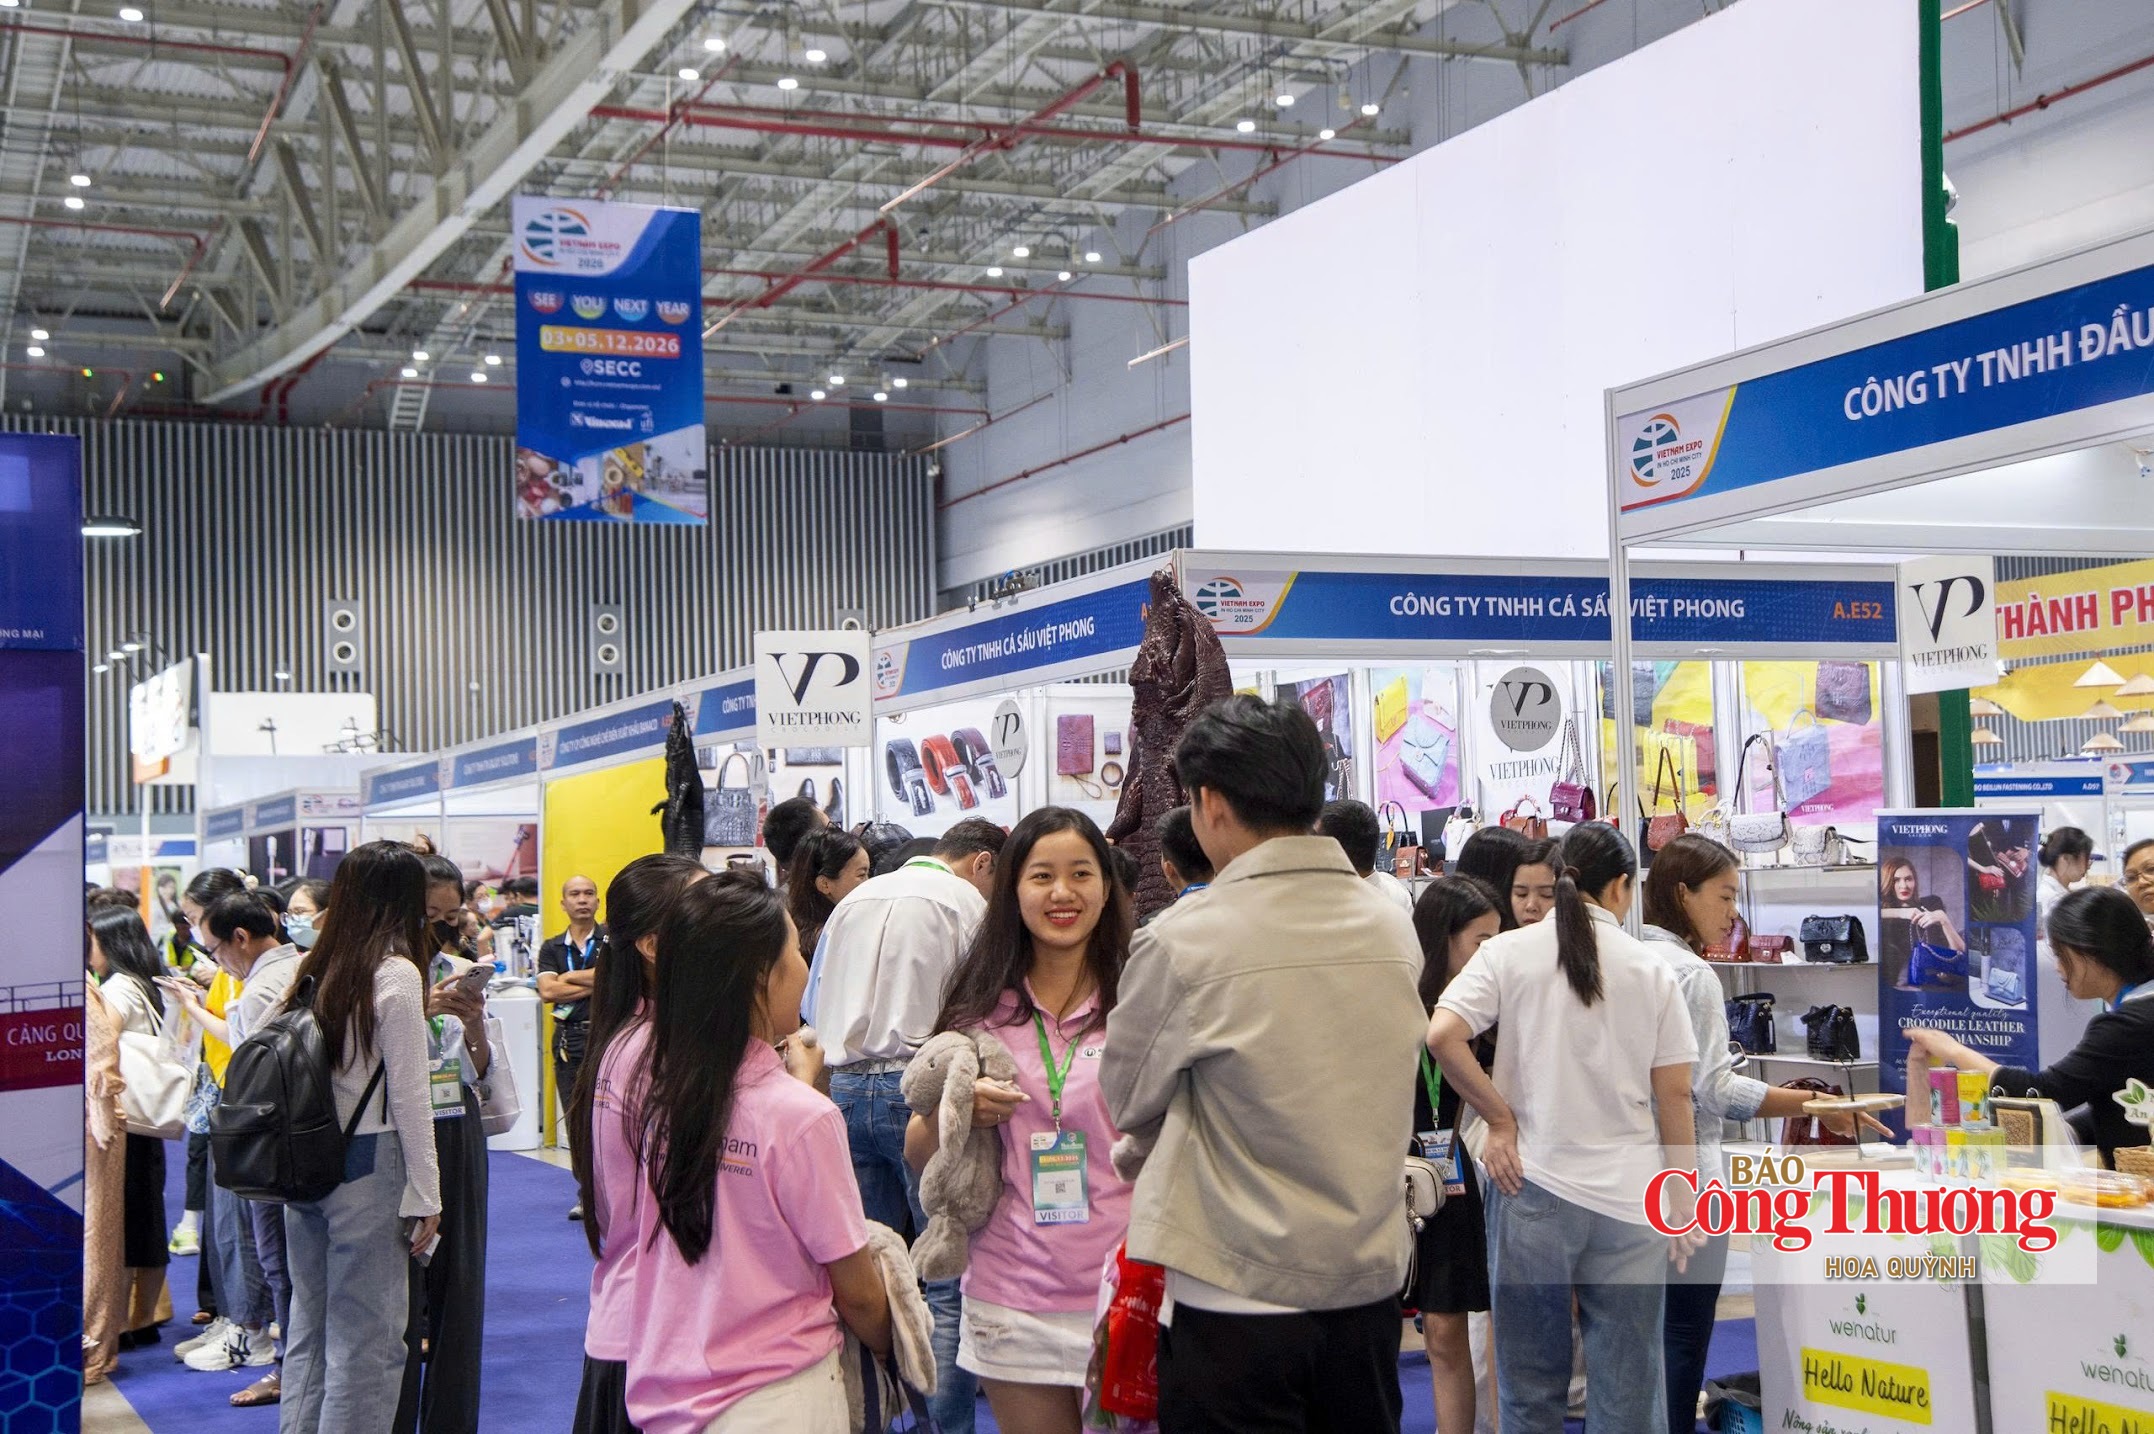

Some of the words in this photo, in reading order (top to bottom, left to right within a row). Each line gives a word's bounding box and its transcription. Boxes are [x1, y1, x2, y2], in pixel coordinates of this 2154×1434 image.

[534, 292, 557, 308] SEE
[572, 294, 602, 310] YOU
[614, 298, 648, 312] NEXT
[655, 301, 688, 315] YEAR
[1844, 377, 1928, 420] CÔNG
[1932, 358, 1972, 398] TY
[1976, 330, 2072, 387] TNHH
[1657, 444, 1685, 459] VIETNAM
[1686, 440, 1702, 453] EXPO
[1671, 466, 1690, 480] 2025
[1390, 592, 1450, 616] CÔNG
[1454, 597, 1480, 616] TY
[1485, 597, 1543, 616] TNHH
[1549, 594, 1576, 617] CÁ
[1674, 599, 1744, 618] PHONG
[1833, 602, 1882, 619] A.E52
[942, 650, 966, 670] CÔNG
[966, 648, 977, 664] TY
[978, 643, 1002, 662] TNHH
[1003, 638, 1015, 655] CÁ
[1017, 628, 1035, 653] SẤU
[1036, 624, 1058, 650] VIỆT
[1058, 616, 1094, 642] PHONG
[1912, 644, 1987, 668] VIETPHONG
[766, 652, 860, 706] VP
[722, 696, 737, 714] CÔNG
[1501, 682, 1552, 717] VP
[768, 711, 860, 725] VIETPHONG
[1501, 720, 1552, 730] VIETPHONG
[996, 746, 1021, 760] VIETPHONG
[1490, 756, 1559, 780] VIETPHONG
[1801, 804, 1834, 813] VIETPHONG
[1892, 824, 1948, 834] VIETPHONG
[1911, 1004, 1969, 1018] Exceptional
[1971, 1006, 2010, 1020] quality
[7, 1023, 57, 1046] CẢNG
[1898, 1017, 1967, 1031] CROCODILE
[1969, 1020, 2025, 1034] LEATHER
[434, 1108, 462, 1116] VISITOR
[1040, 1211, 1084, 1220] VISITOR
[1805, 1357, 1852, 1392] Hello
[1862, 1368, 1928, 1408] Nature
[1782, 1408, 1813, 1431] Nông
[2050, 1402, 2110, 1434] Hello
